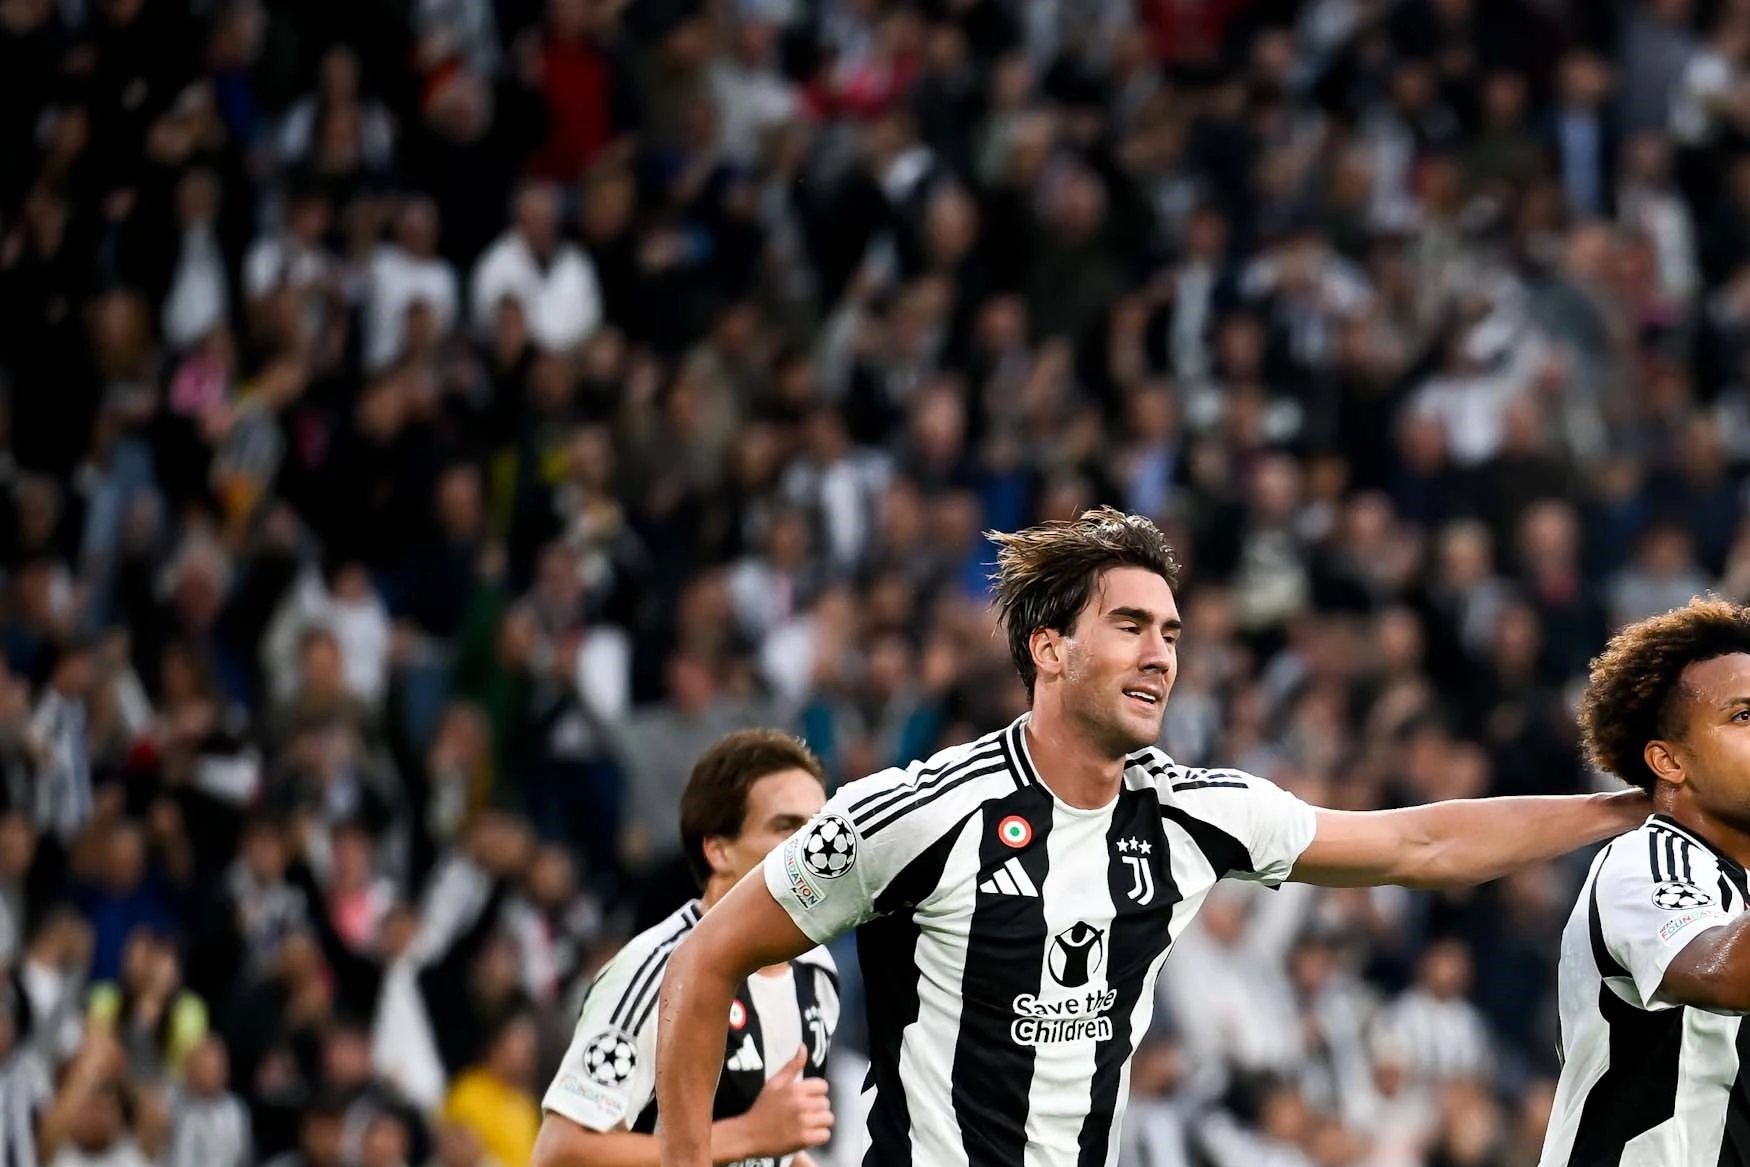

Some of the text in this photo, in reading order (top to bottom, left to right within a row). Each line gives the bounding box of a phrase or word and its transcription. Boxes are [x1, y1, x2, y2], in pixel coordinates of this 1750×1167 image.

[1016, 989, 1115, 1015] Save the
[1014, 1019, 1110, 1043] Children
